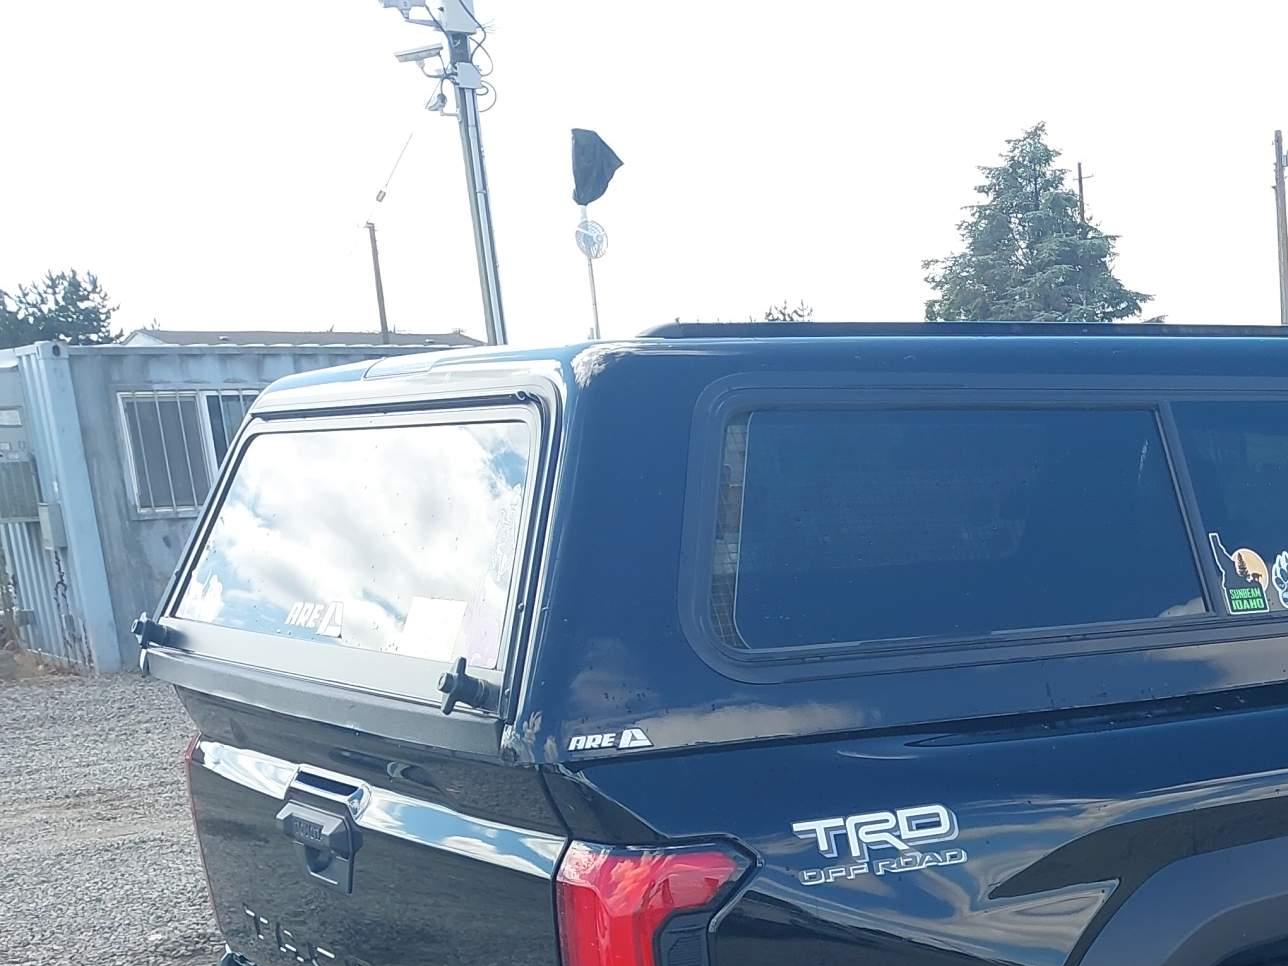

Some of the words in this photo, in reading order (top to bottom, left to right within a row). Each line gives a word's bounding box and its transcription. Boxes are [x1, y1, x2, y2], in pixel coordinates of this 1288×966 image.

[1229, 587, 1261, 599] SUNBEAM
[1232, 598, 1265, 610] IDAHO
[792, 804, 959, 862] TRD
[799, 861, 870, 886] OFF
[873, 848, 968, 876] ROAD
